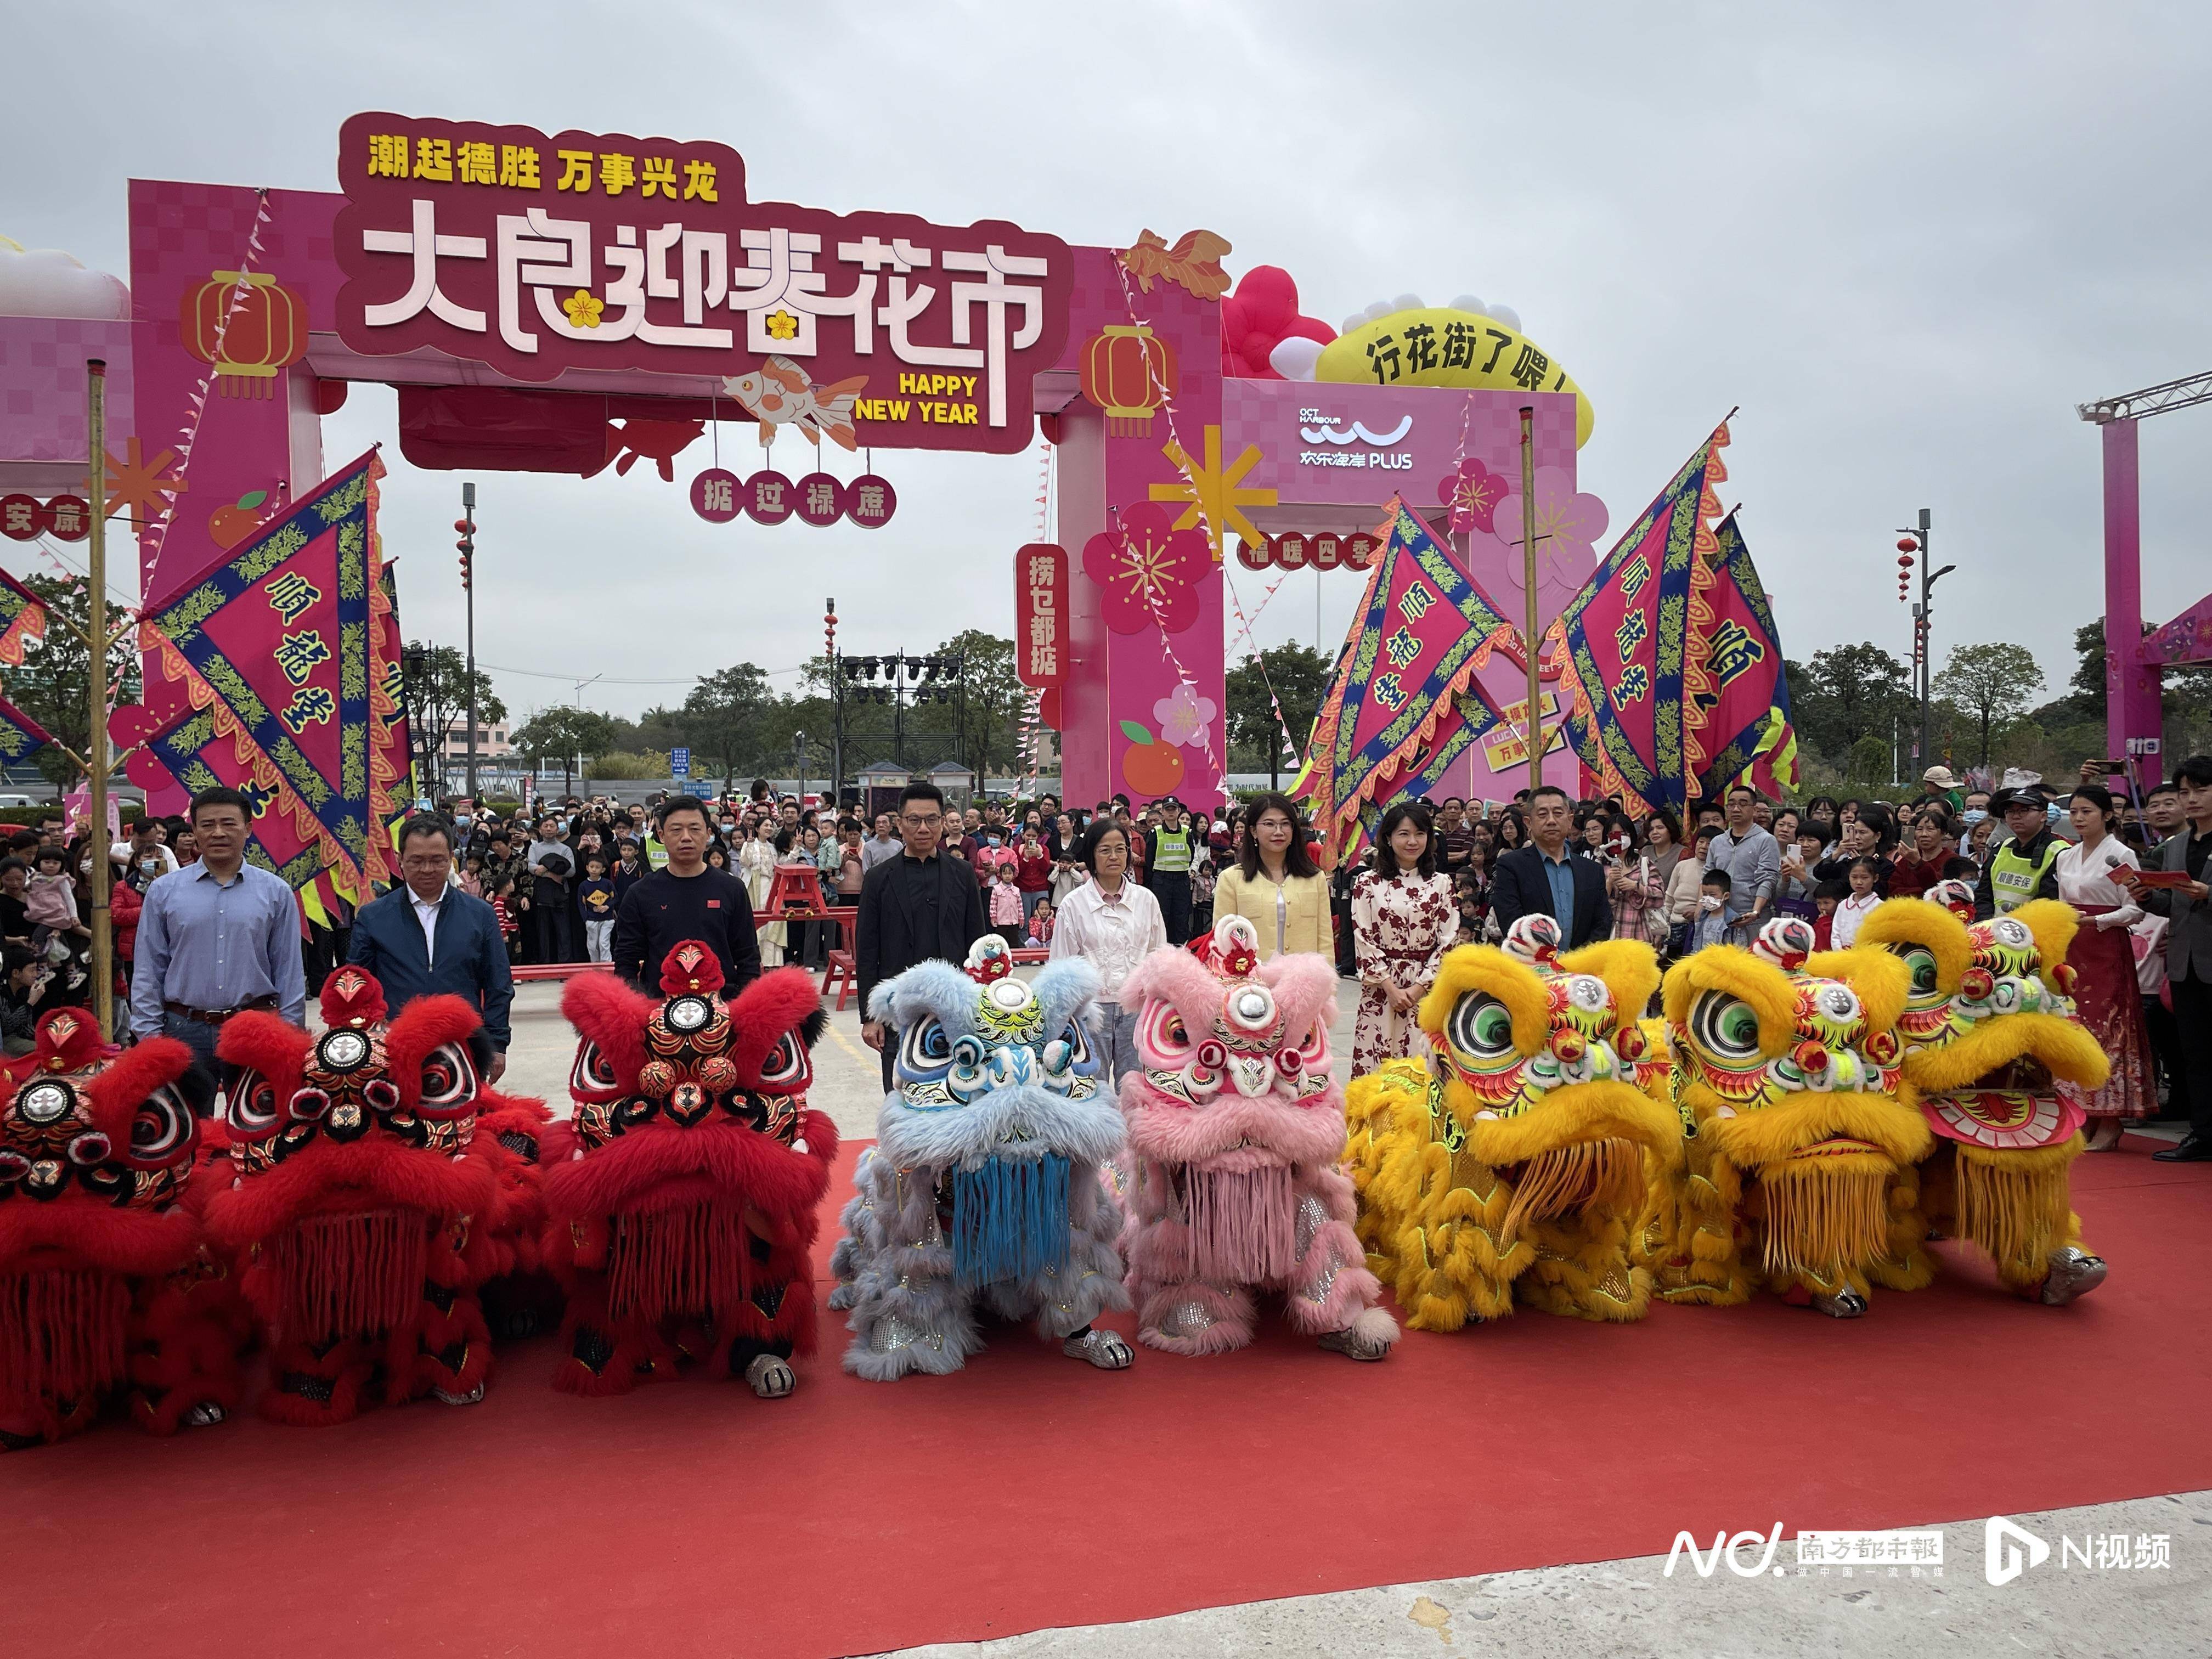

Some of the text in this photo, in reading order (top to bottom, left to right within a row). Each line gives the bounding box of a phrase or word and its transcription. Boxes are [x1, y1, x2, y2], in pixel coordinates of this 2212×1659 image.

[368, 134, 718, 202] 潮起德胜 万事兴龙
[363, 199, 1048, 427] 大良迎春花市
[899, 373, 978, 397] HAPPY
[855, 399, 978, 425] NEW YEAR
[1300, 408, 1319, 416] OCT
[1300, 416, 1341, 425] HARBOUR
[1300, 450, 1413, 470] 欢乐海岸 PLUS
[704, 479, 885, 518] 掂过禄蔗
[5, 502, 81, 533] 安康
[1248, 539, 1370, 564] 福暖四季
[1029, 556, 1057, 676] 捞乜都掂
